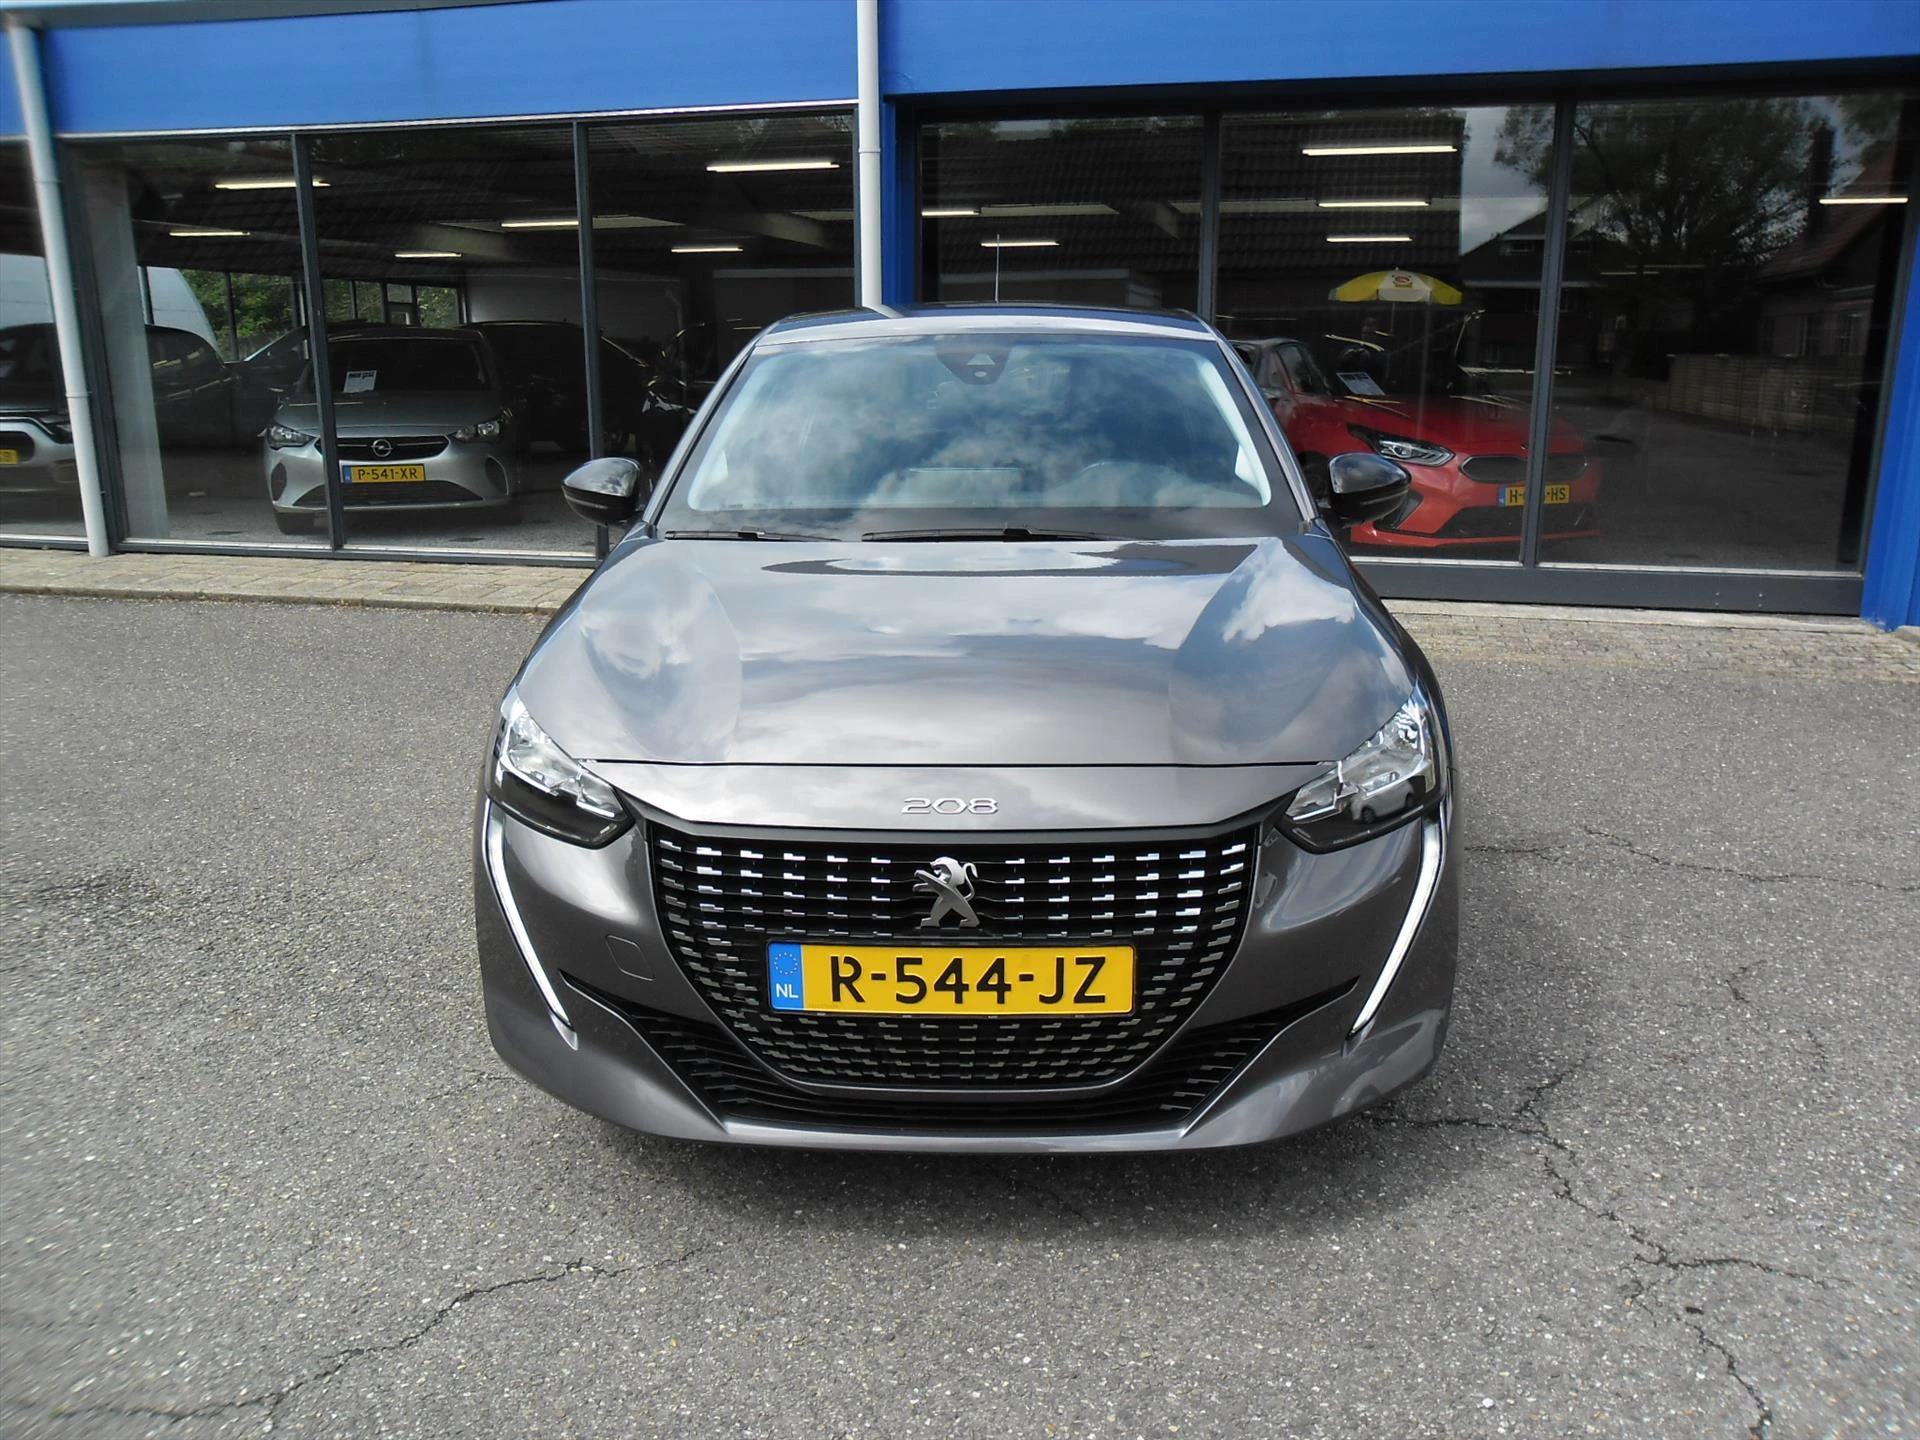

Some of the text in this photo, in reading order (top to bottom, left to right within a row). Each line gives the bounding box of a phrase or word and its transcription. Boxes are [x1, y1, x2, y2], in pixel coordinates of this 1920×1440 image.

[358, 468, 418, 480] P-541-XR
[901, 797, 999, 815] 208
[830, 955, 1106, 1004] R-544-JZ
[775, 983, 799, 998] NL
